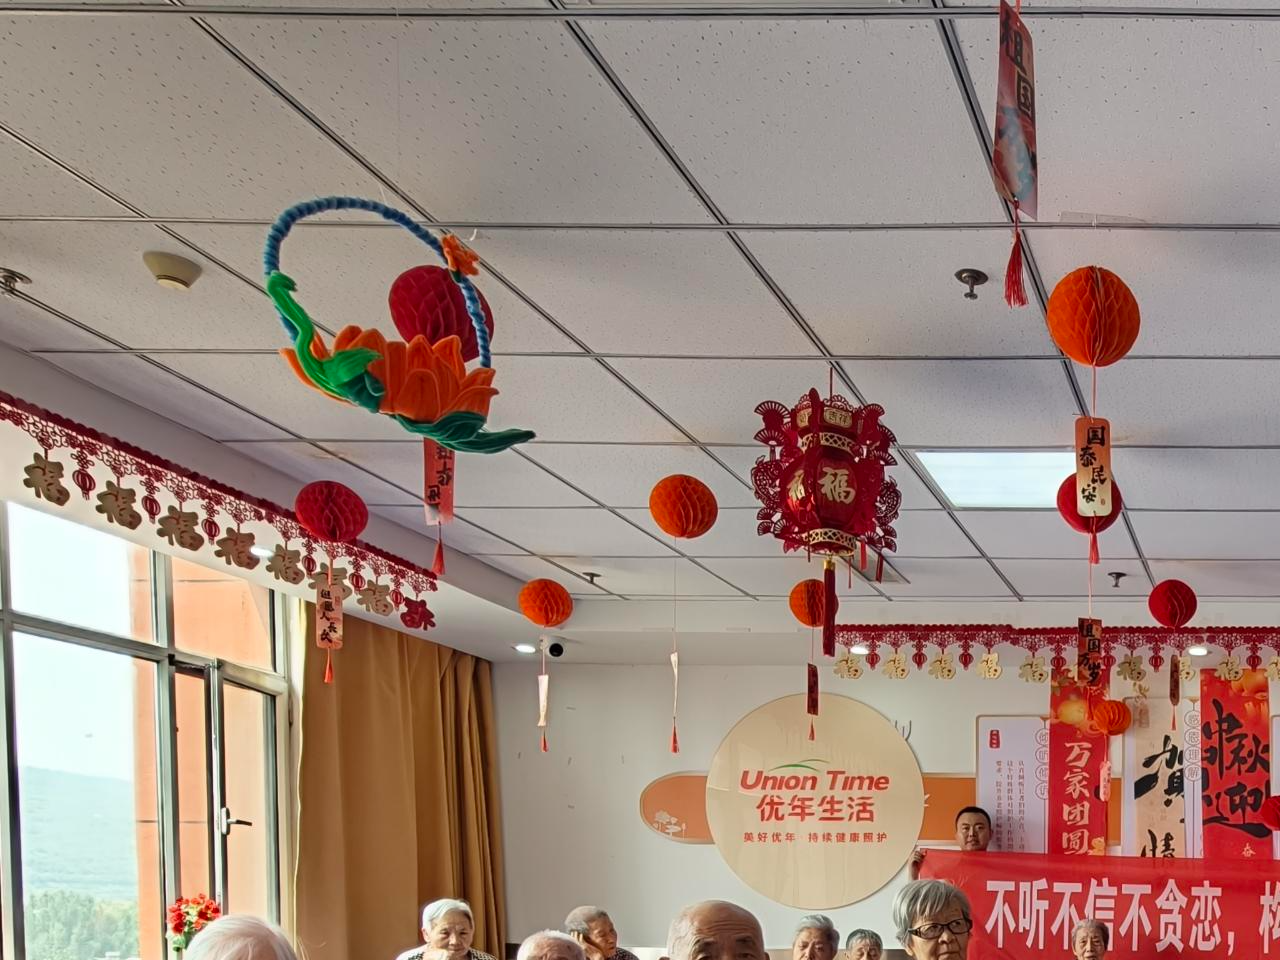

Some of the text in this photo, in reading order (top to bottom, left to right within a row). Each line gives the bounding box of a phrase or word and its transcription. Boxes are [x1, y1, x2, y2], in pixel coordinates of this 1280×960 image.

[818, 467, 856, 504] 福
[1079, 426, 1107, 503] 国泰民安
[1078, 619, 1101, 684] 祖国万岁
[1202, 698, 1271, 780] 中秋
[740, 770, 890, 791] Union Time
[1062, 742, 1091, 856] 万家团圆
[756, 794, 875, 822] 优年生活
[744, 832, 887, 843] 美好优年 持续健康照护
